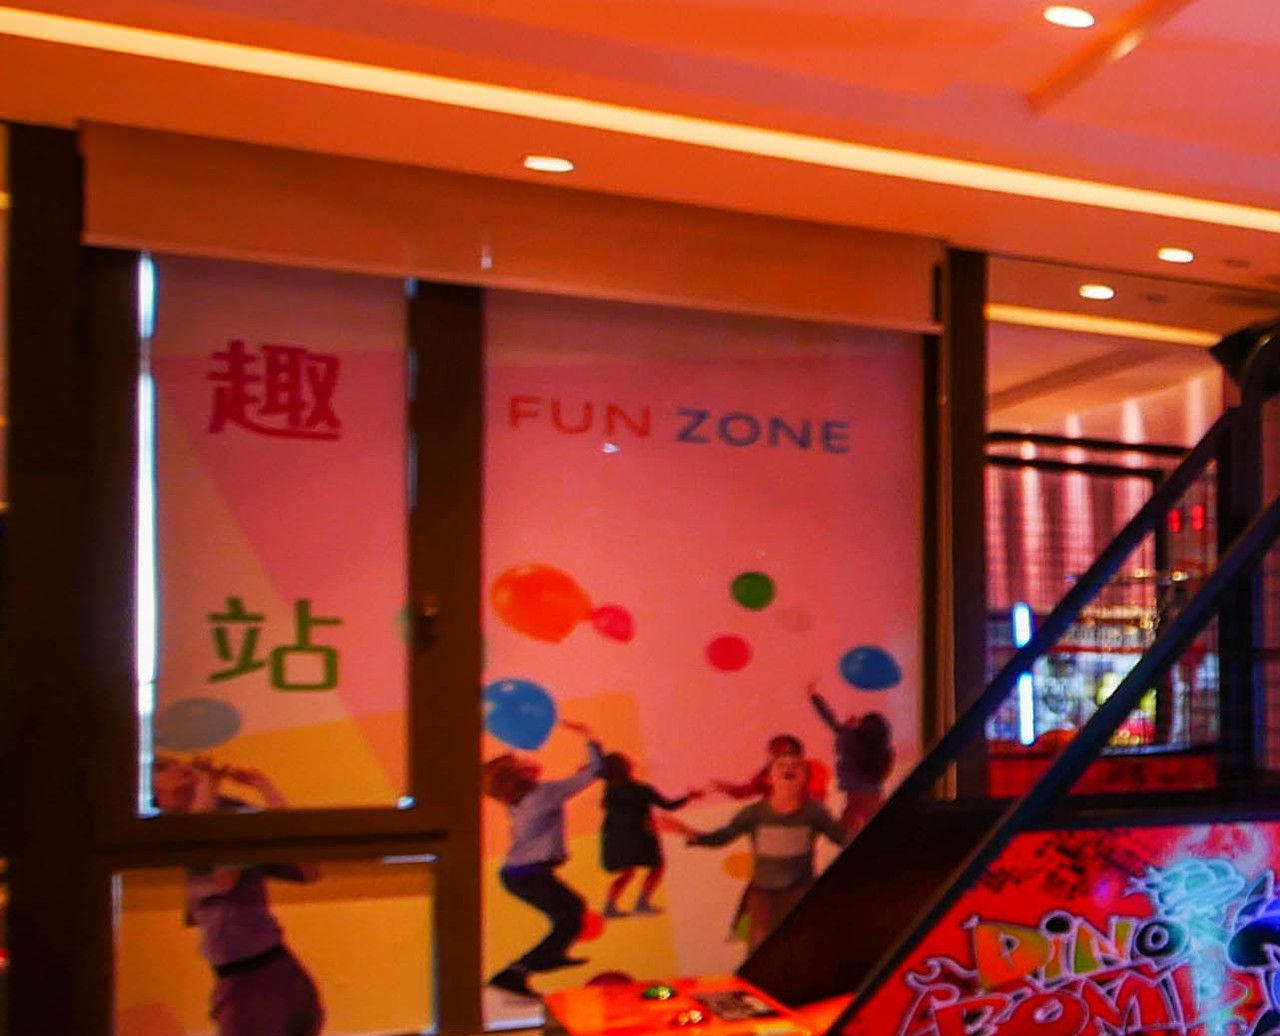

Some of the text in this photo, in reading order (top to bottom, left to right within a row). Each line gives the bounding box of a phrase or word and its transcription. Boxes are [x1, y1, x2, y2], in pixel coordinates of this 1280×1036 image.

[207, 339, 342, 442] 趣
[507, 394, 852, 455] FUN ZONE
[207, 597, 342, 693] 站
[963, 909, 1190, 993] DINO
